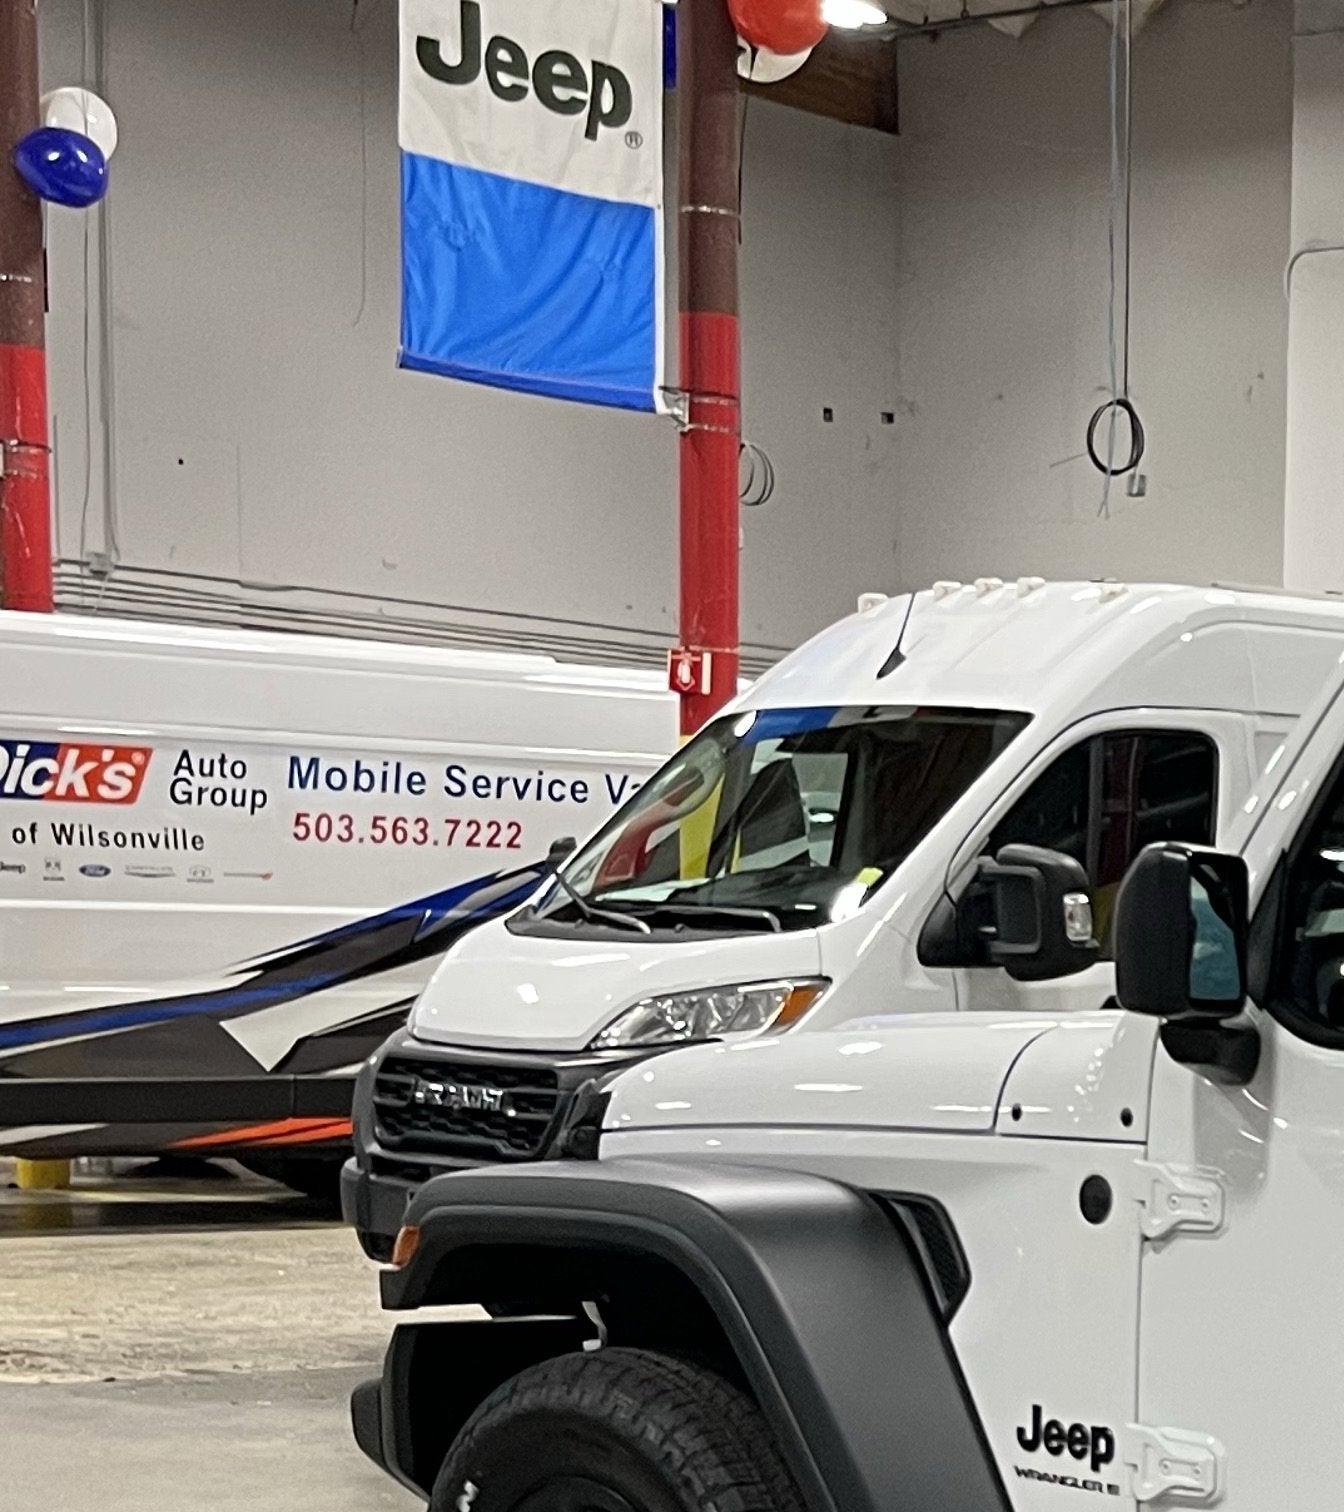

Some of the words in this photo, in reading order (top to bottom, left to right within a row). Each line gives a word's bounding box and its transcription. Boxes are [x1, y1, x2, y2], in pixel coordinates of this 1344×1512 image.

[416, 0, 632, 141] Jeep
[173, 749, 248, 779] Auto
[288, 755, 427, 796] Mobile
[444, 764, 589, 803] Service
[169, 777, 268, 815] Group
[12, 822, 37, 845] of
[51, 822, 206, 851] Wilsonville
[292, 812, 523, 850] 503.563.7222
[1016, 1404, 1116, 1472] Jeep
